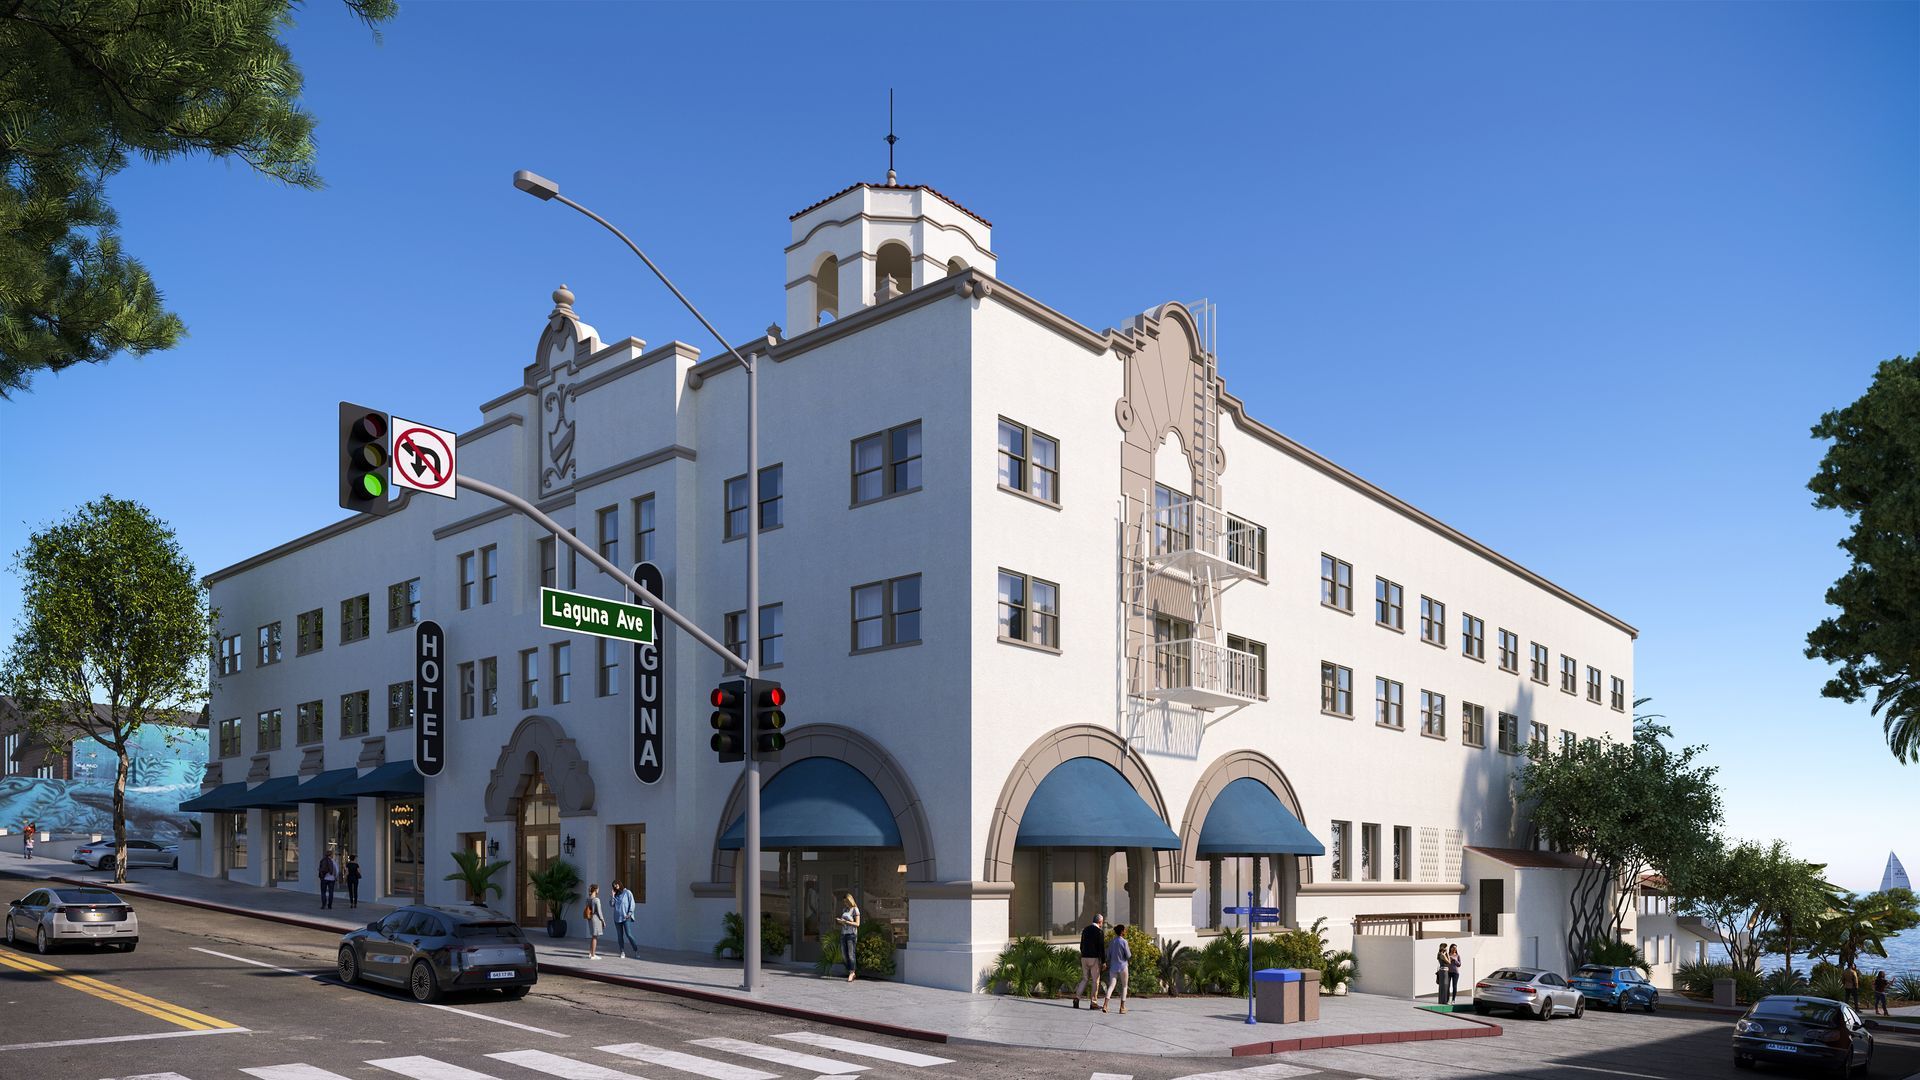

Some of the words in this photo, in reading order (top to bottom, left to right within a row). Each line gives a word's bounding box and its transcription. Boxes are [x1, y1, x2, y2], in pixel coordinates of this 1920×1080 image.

[552, 595, 608, 627] Laguna
[617, 609, 643, 632] Ave
[421, 634, 439, 762] HOTEL
